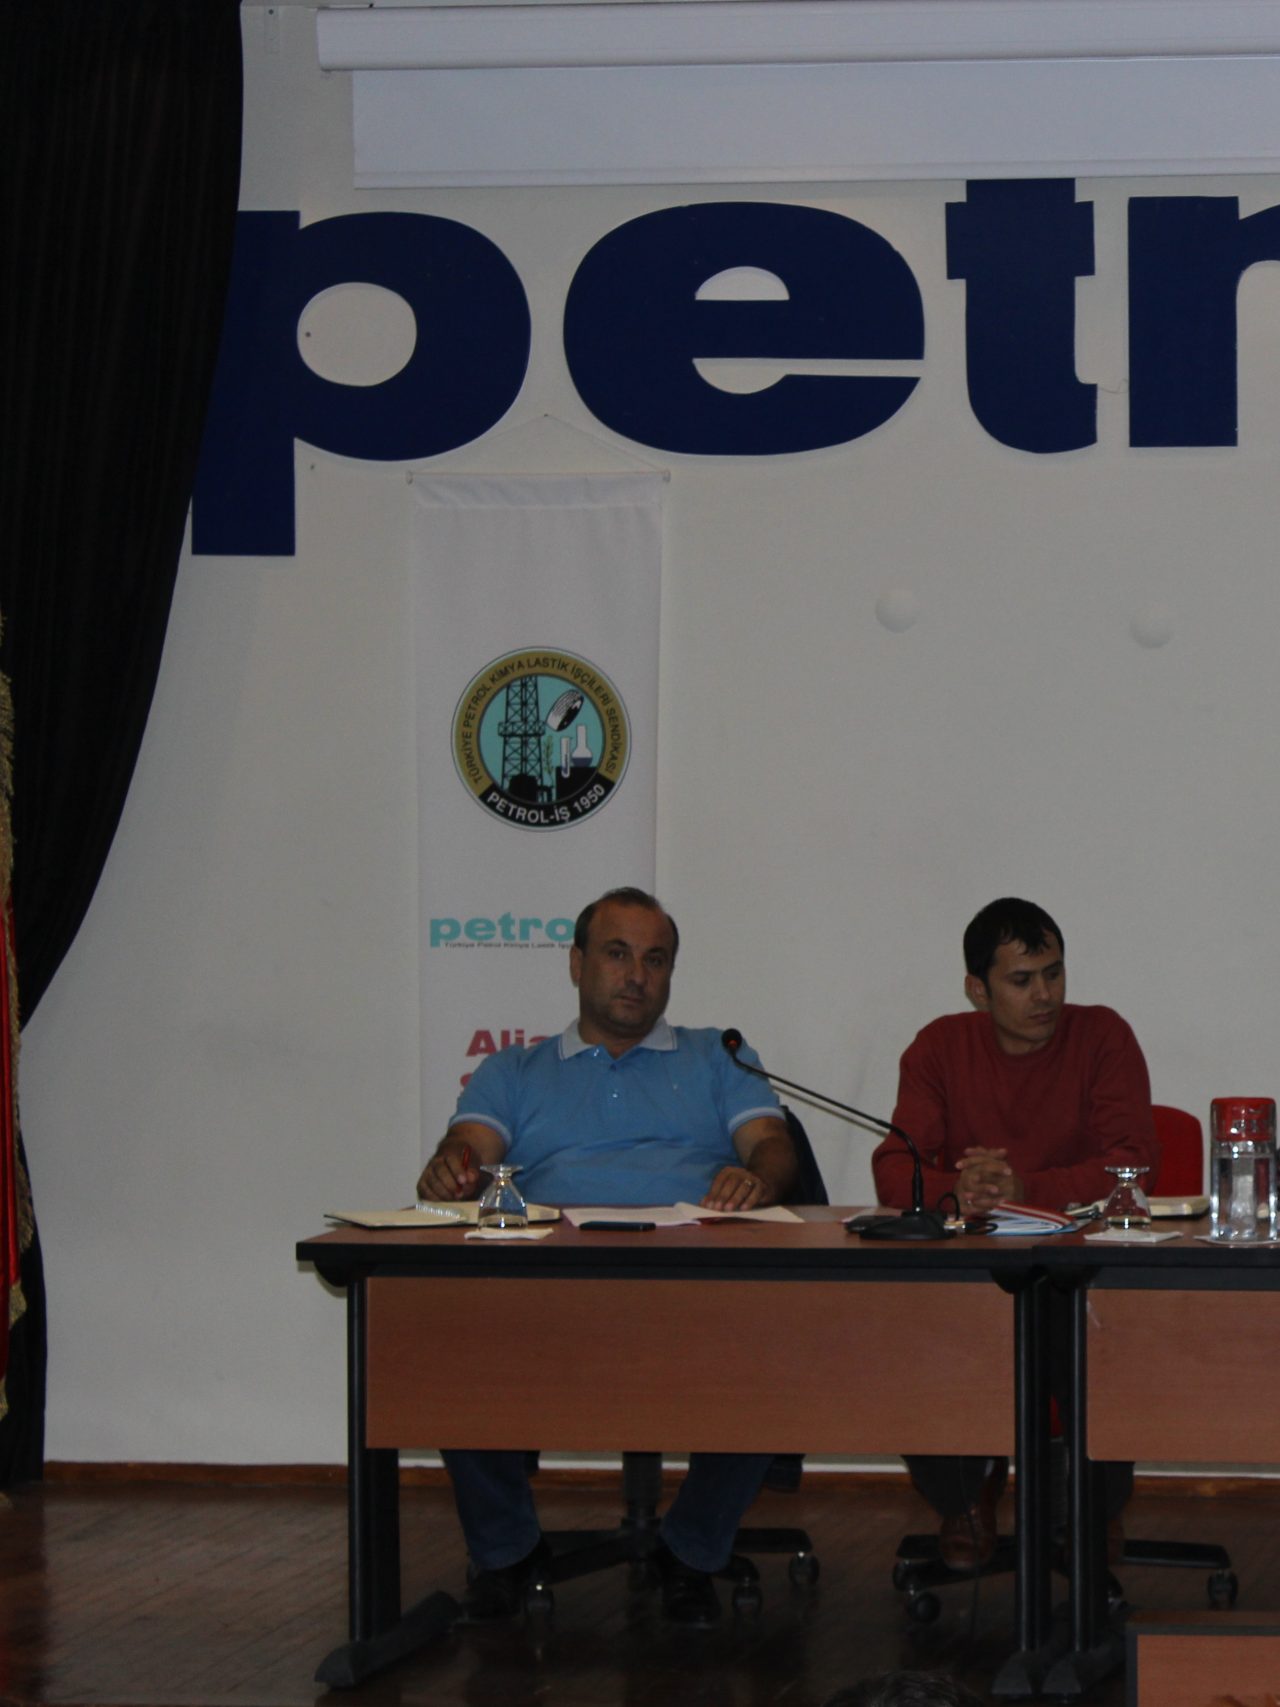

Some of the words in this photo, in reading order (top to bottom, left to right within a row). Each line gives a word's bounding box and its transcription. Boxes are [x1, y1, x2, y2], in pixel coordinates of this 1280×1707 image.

[491, 660, 526, 683] KİMYA
[527, 656, 570, 673] LASTİK
[463, 684, 493, 729] PETROL
[461, 730, 484, 785] TÜRKİYE
[486, 791, 572, 825] PETROL-İŞ
[572, 783, 607, 814] 1950
